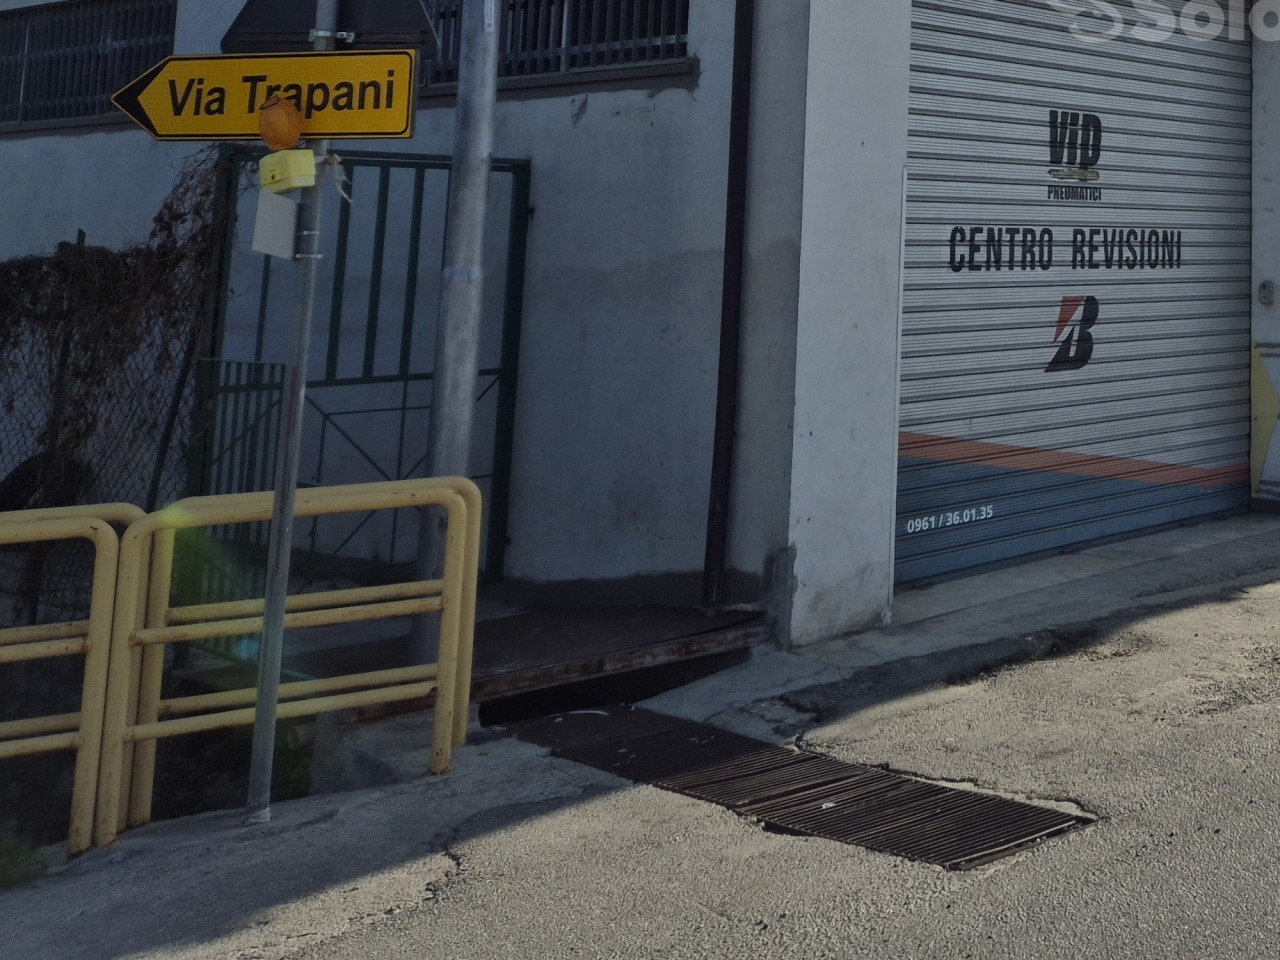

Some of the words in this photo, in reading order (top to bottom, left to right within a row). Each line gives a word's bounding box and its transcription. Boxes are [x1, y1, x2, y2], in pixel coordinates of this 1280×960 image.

[168, 78, 226, 117] Via
[242, 70, 395, 119] Trapani
[1047, 186, 1102, 201] PNEUMATICI
[950, 226, 1053, 272] CENTRO
[1071, 228, 1182, 270] REVISIONI
[907, 515, 935, 534] 0961
[945, 505, 994, 526] 36.01.35
